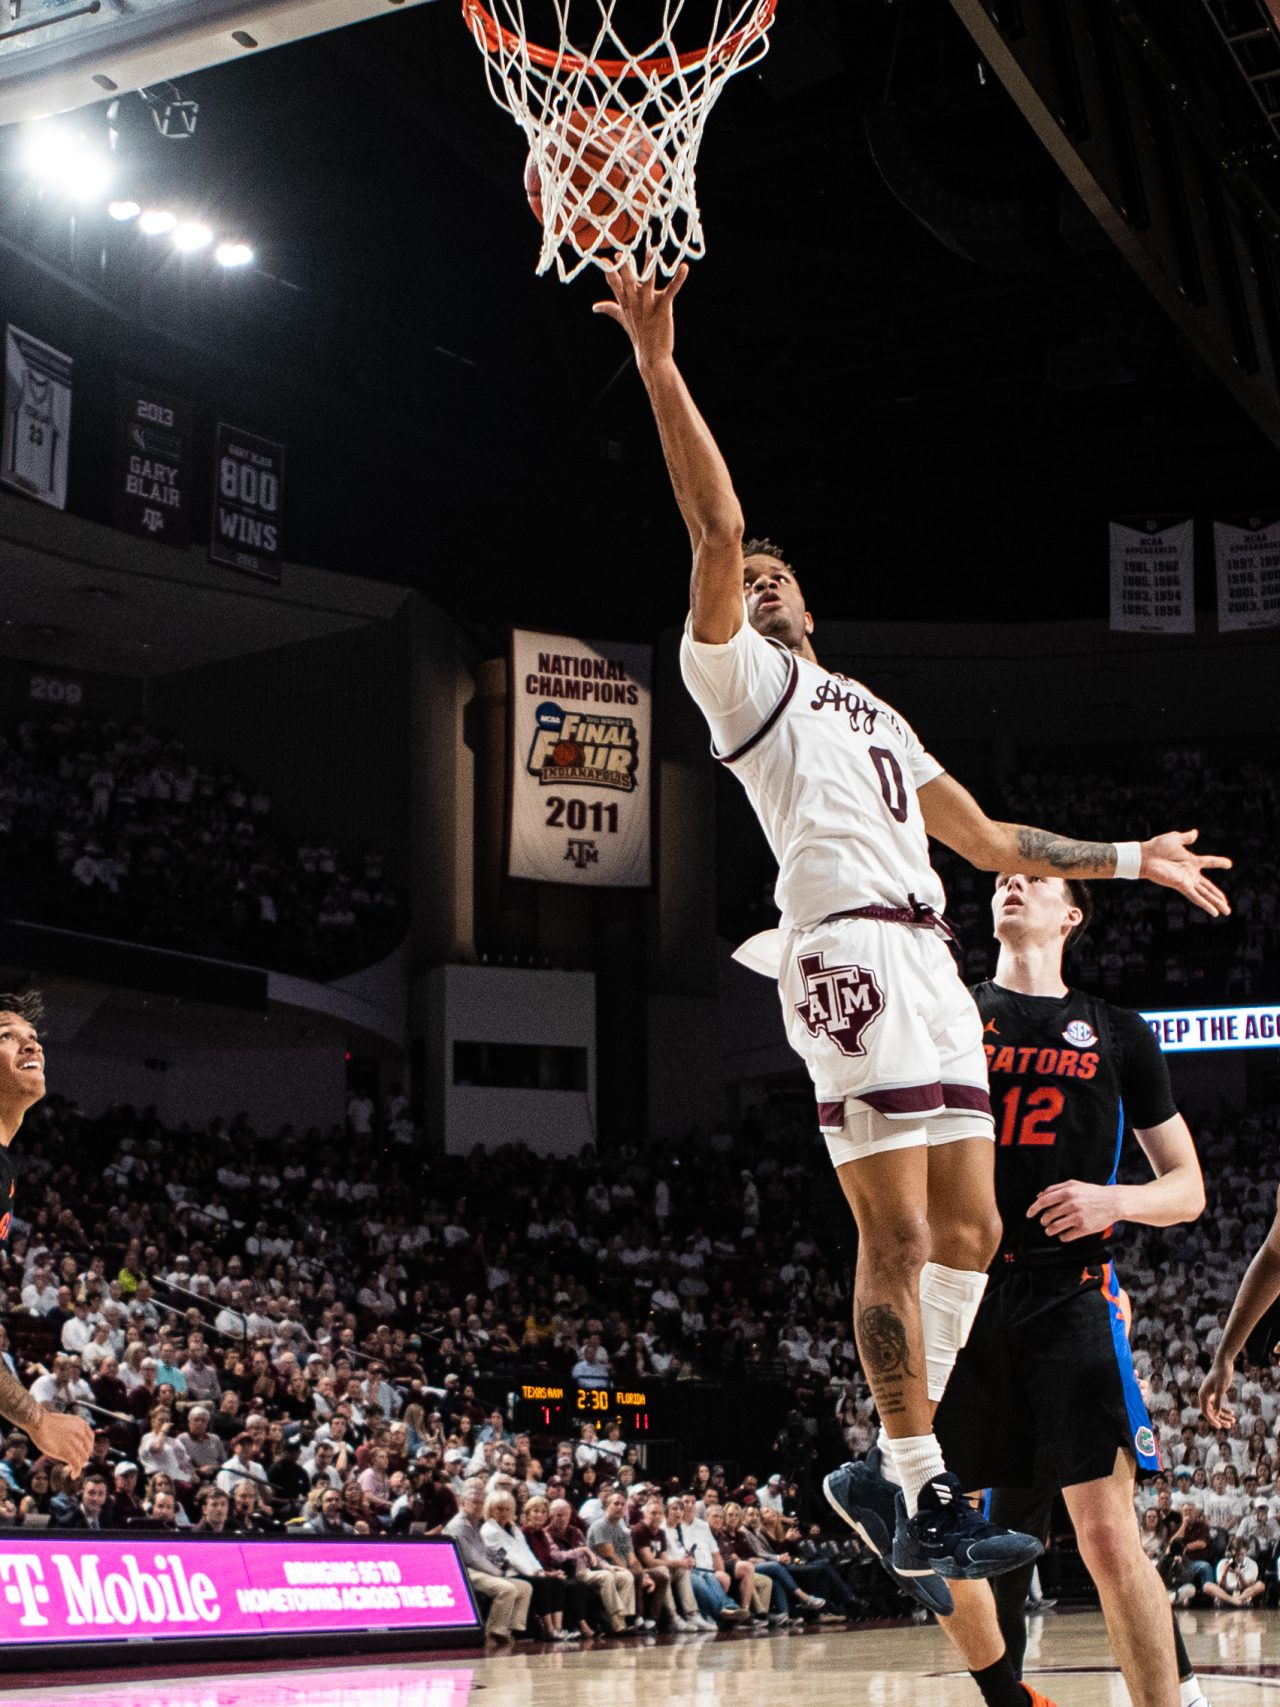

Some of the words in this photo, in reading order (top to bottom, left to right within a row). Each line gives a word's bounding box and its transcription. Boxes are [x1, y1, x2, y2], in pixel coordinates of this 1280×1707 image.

[137, 399, 173, 427] 2013
[129, 455, 179, 486] GARY
[220, 456, 279, 512] 800
[125, 474, 181, 508] BLAIR
[219, 507, 278, 552] WINS
[538, 653, 627, 682] NATIONAL
[30, 676, 82, 704] 209
[525, 674, 639, 705] CHAMPIONS
[560, 714, 632, 746] FINAL
[542, 766, 630, 788] INDIANAPOLIS
[867, 745, 907, 824] 0
[545, 796, 618, 833] 2011
[1196, 1015, 1239, 1042] THE
[1000, 1086, 1065, 1146] 12
[522, 1386, 547, 1399] TEXAS
[577, 1389, 609, 1411] 2:30
[616, 1392, 646, 1406] FLORIDA
[635, 1412, 649, 1430] 11
[51, 1554, 221, 1626] Mobile
